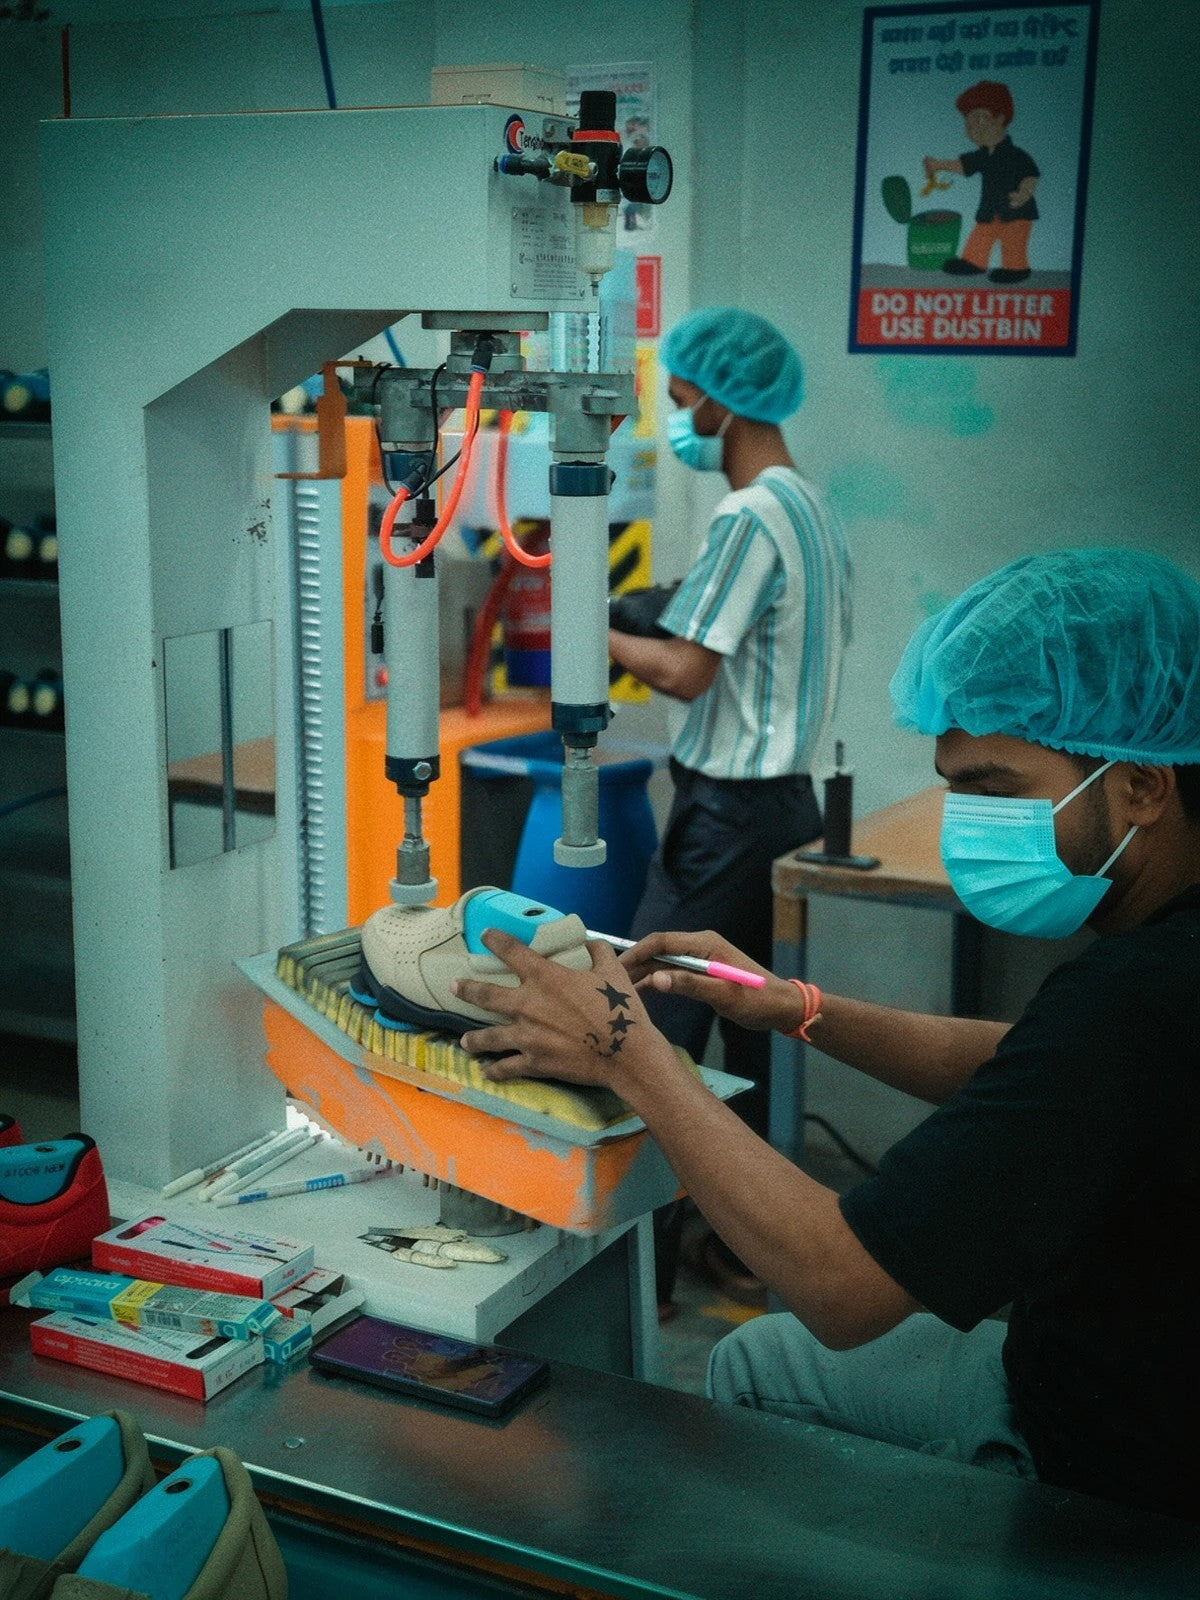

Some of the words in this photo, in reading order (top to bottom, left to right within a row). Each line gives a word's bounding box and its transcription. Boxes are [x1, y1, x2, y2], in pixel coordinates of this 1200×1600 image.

[871, 292, 908, 315] DO
[914, 293, 965, 315] NOT
[972, 294, 1055, 316] LITTER
[880, 316, 925, 339] USE
[932, 317, 1042, 340] DUSTBIN
